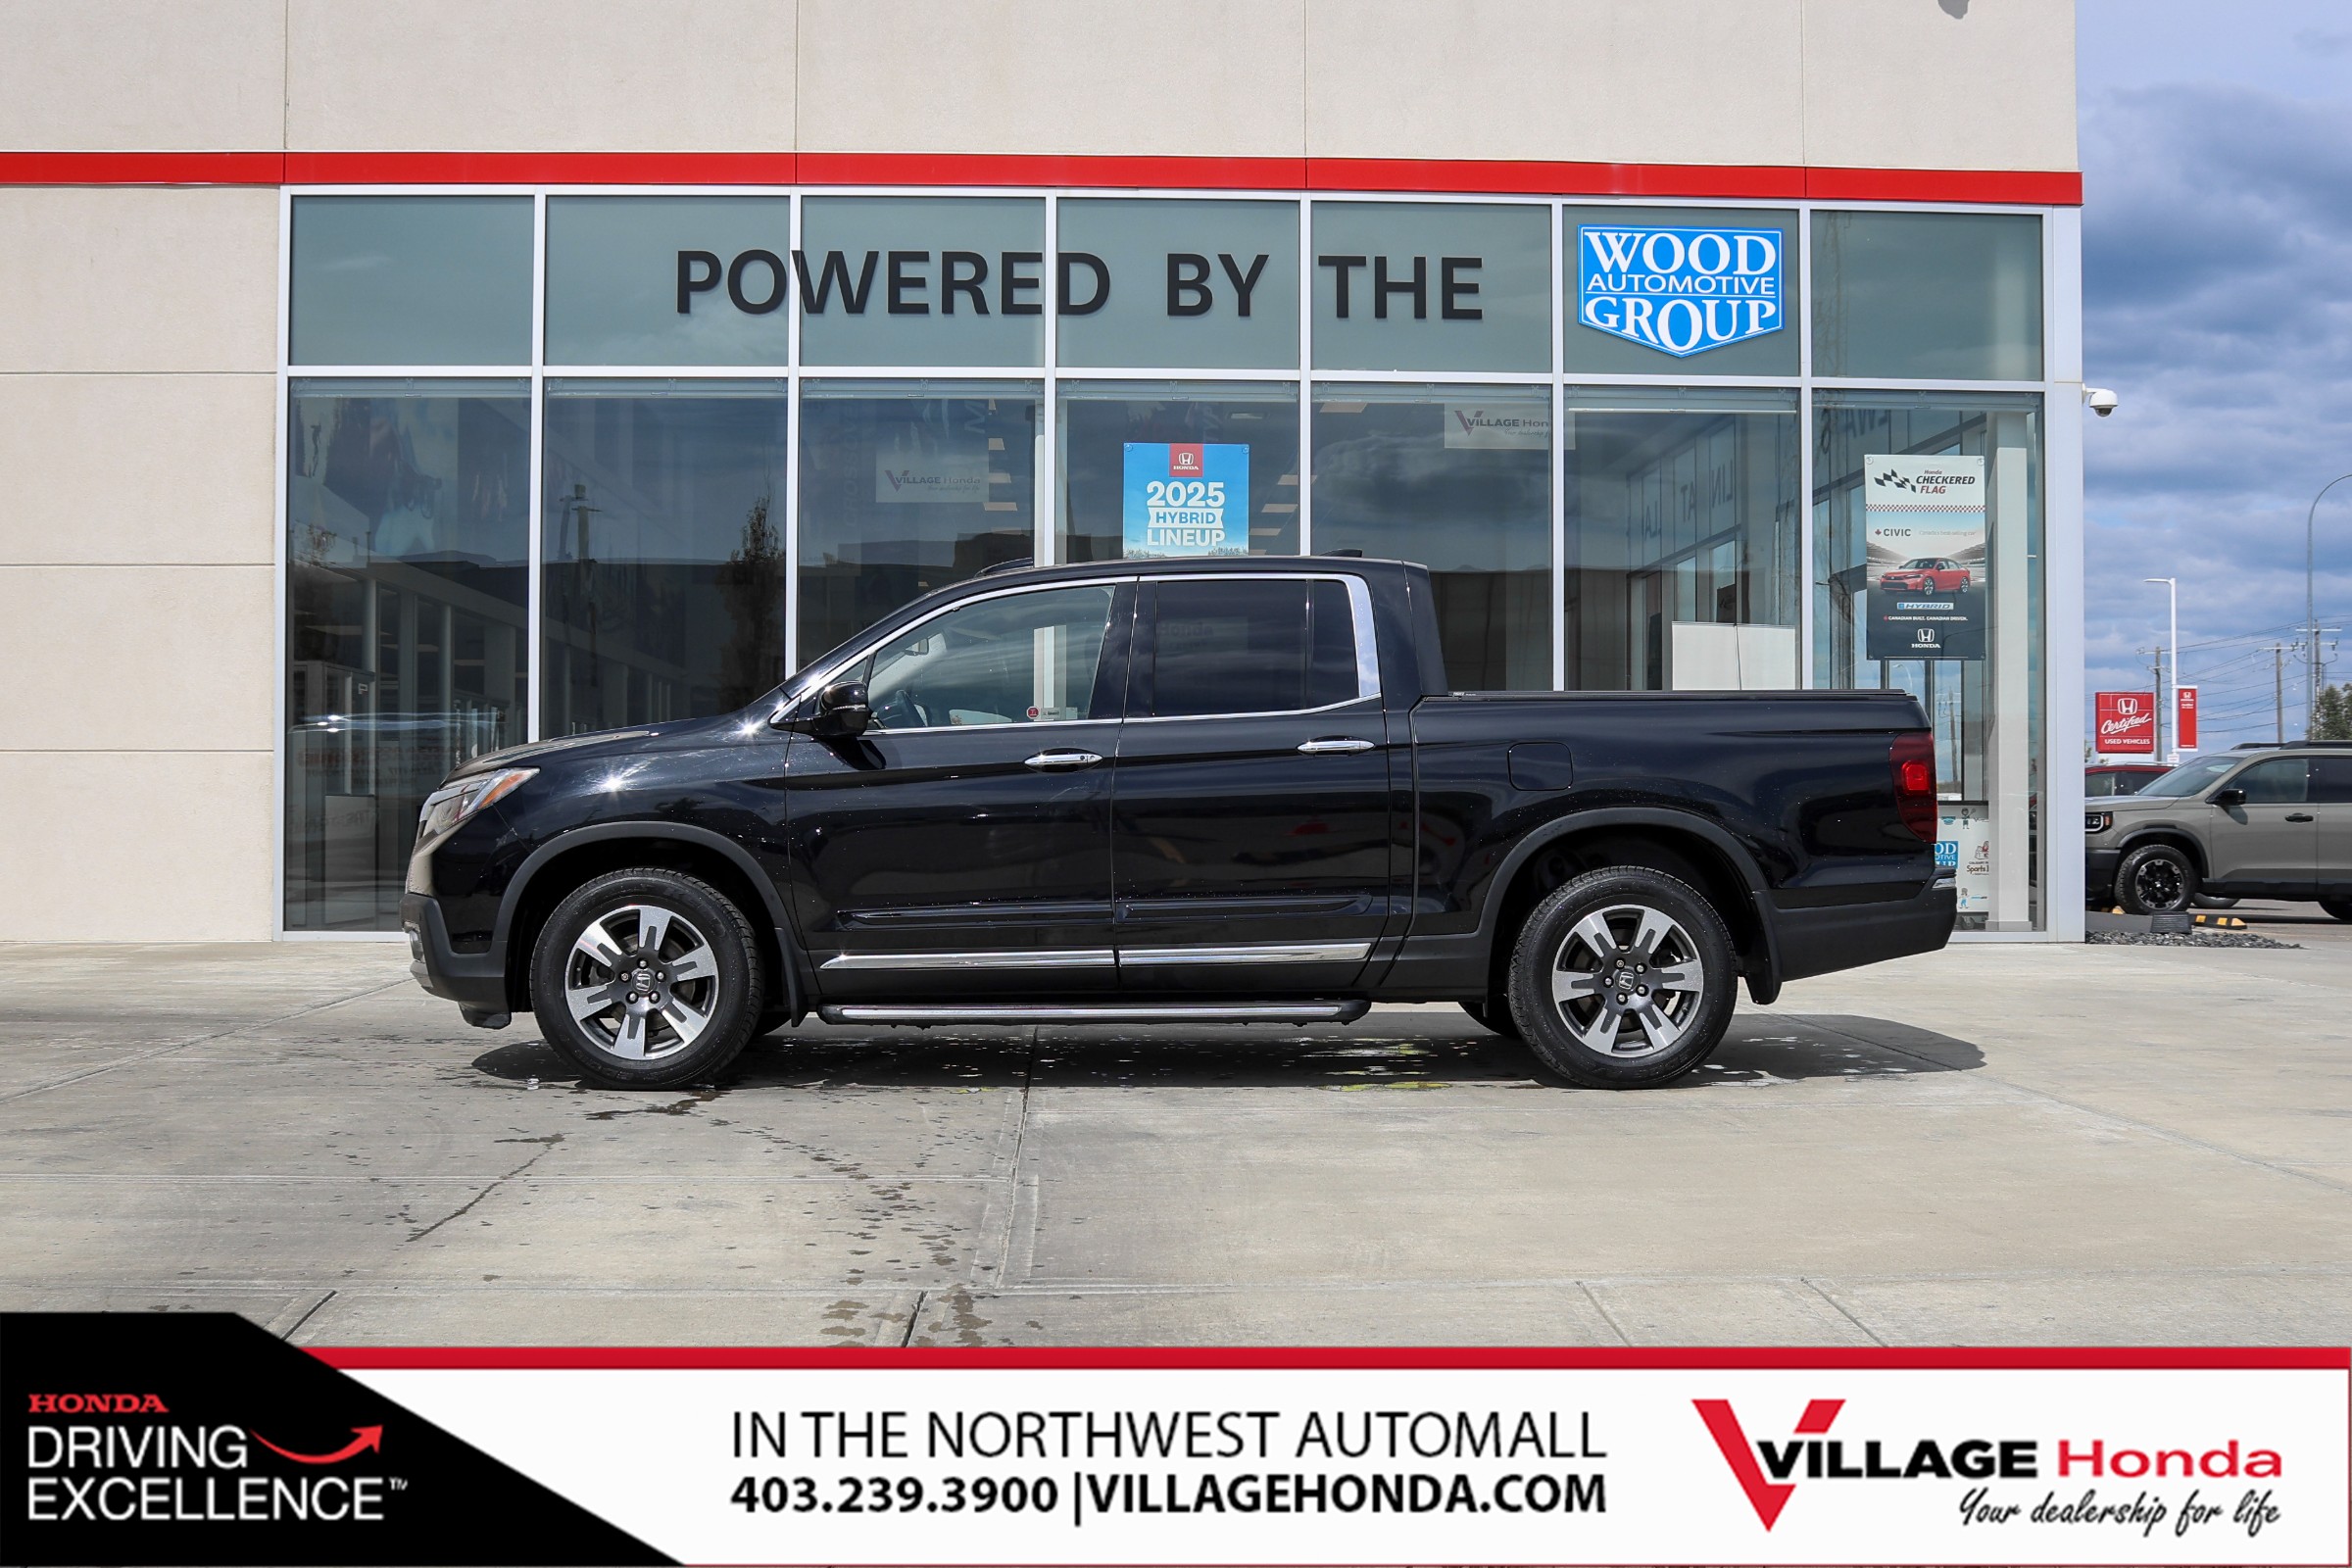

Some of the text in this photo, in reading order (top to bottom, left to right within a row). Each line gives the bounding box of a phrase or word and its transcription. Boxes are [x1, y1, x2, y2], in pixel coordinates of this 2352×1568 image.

[1584, 231, 1777, 275] WOOD
[676, 248, 1484, 320] POWERED BY THE
[1586, 272, 1776, 295] AUTOMOTIVE
[1585, 296, 1777, 352] GROUP
[943, 475, 981, 484] Honda
[1915, 475, 1976, 485] CHECKERED
[1920, 485, 1946, 494] FLAG
[1146, 480, 1226, 508] 2025
[1155, 511, 1217, 524] HYBRID
[1147, 528, 1226, 547] LINEUP
[1883, 528, 1912, 537] CIVIC
[2100, 712, 2152, 735] Certified
